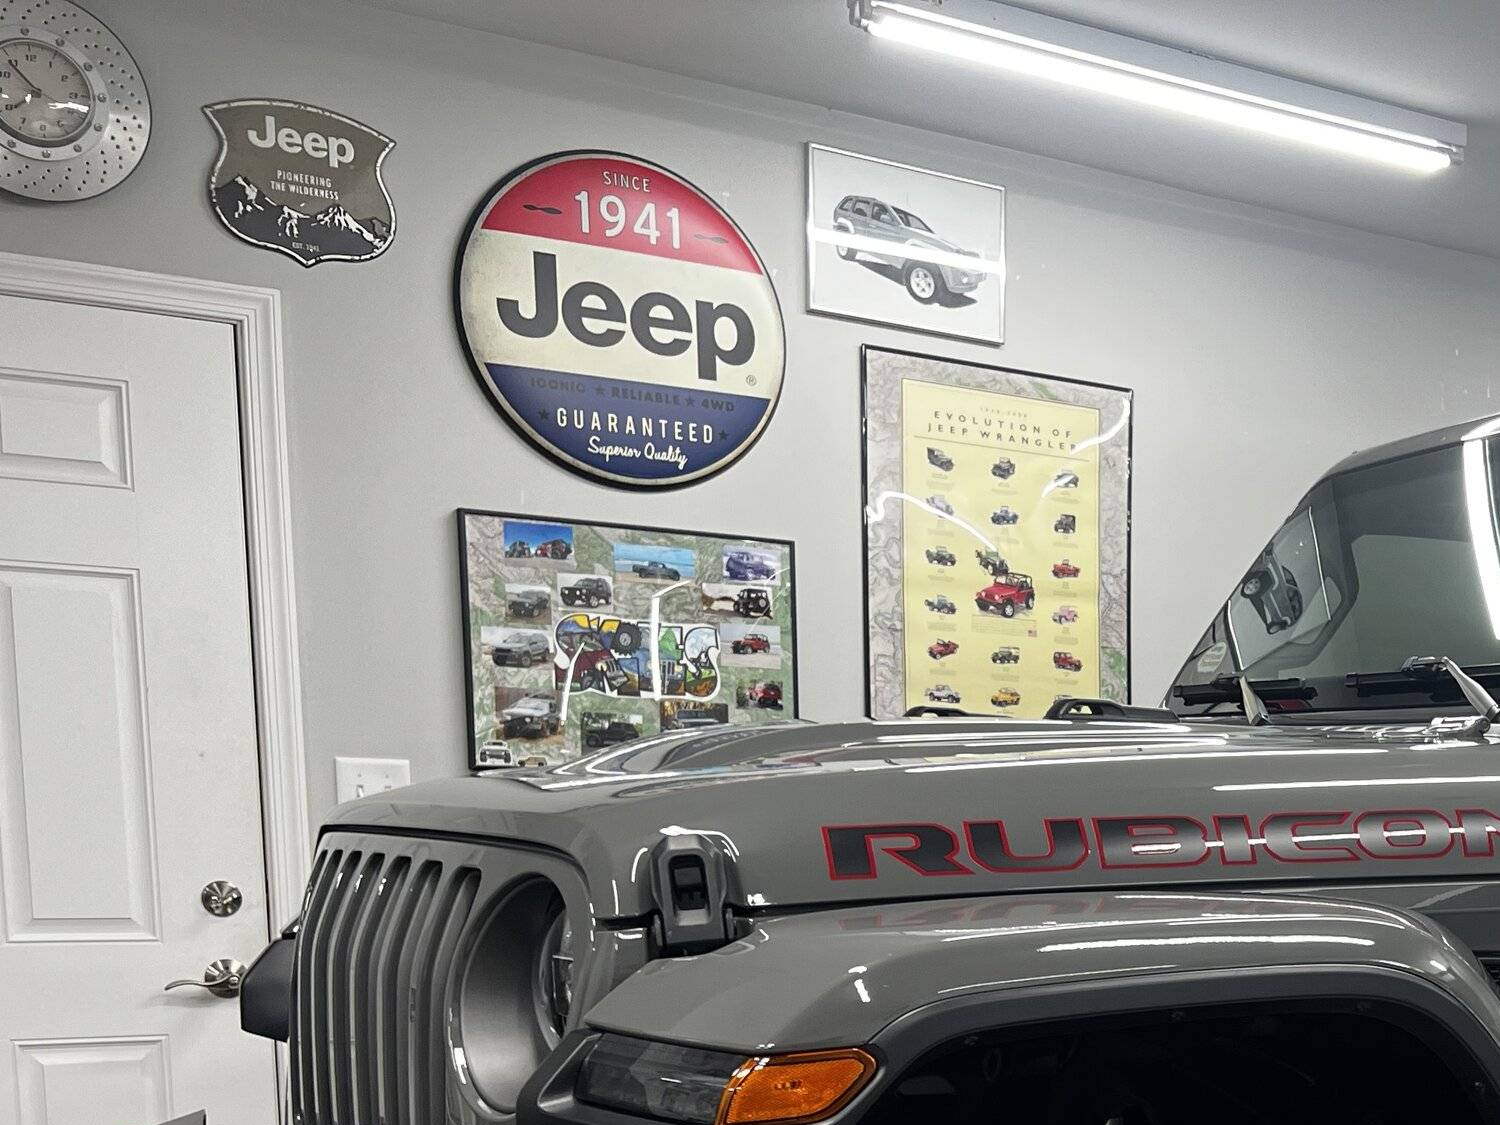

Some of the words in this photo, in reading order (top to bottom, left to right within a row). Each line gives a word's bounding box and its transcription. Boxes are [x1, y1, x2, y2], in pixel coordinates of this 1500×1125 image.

[247, 115, 355, 169] Jeep
[270, 181, 286, 191] THE
[289, 182, 339, 201] WILDERNESS
[276, 169, 332, 188] PIONEERING
[602, 170, 651, 193] SINCE
[573, 190, 682, 250] 1941
[496, 250, 755, 381] Jeep
[529, 377, 586, 393] ICONIC
[611, 386, 680, 406] RELIABLE
[701, 398, 735, 412] 4WD
[556, 407, 714, 444] GUARANTEED
[928, 422, 968, 436] JEEP
[980, 430, 1076, 450] WRANGLER
[933, 410, 1041, 434] EVOLUTION
[1052, 428, 1072, 439] OF
[587, 435, 641, 462] Superior
[644, 442, 689, 469] Quality
